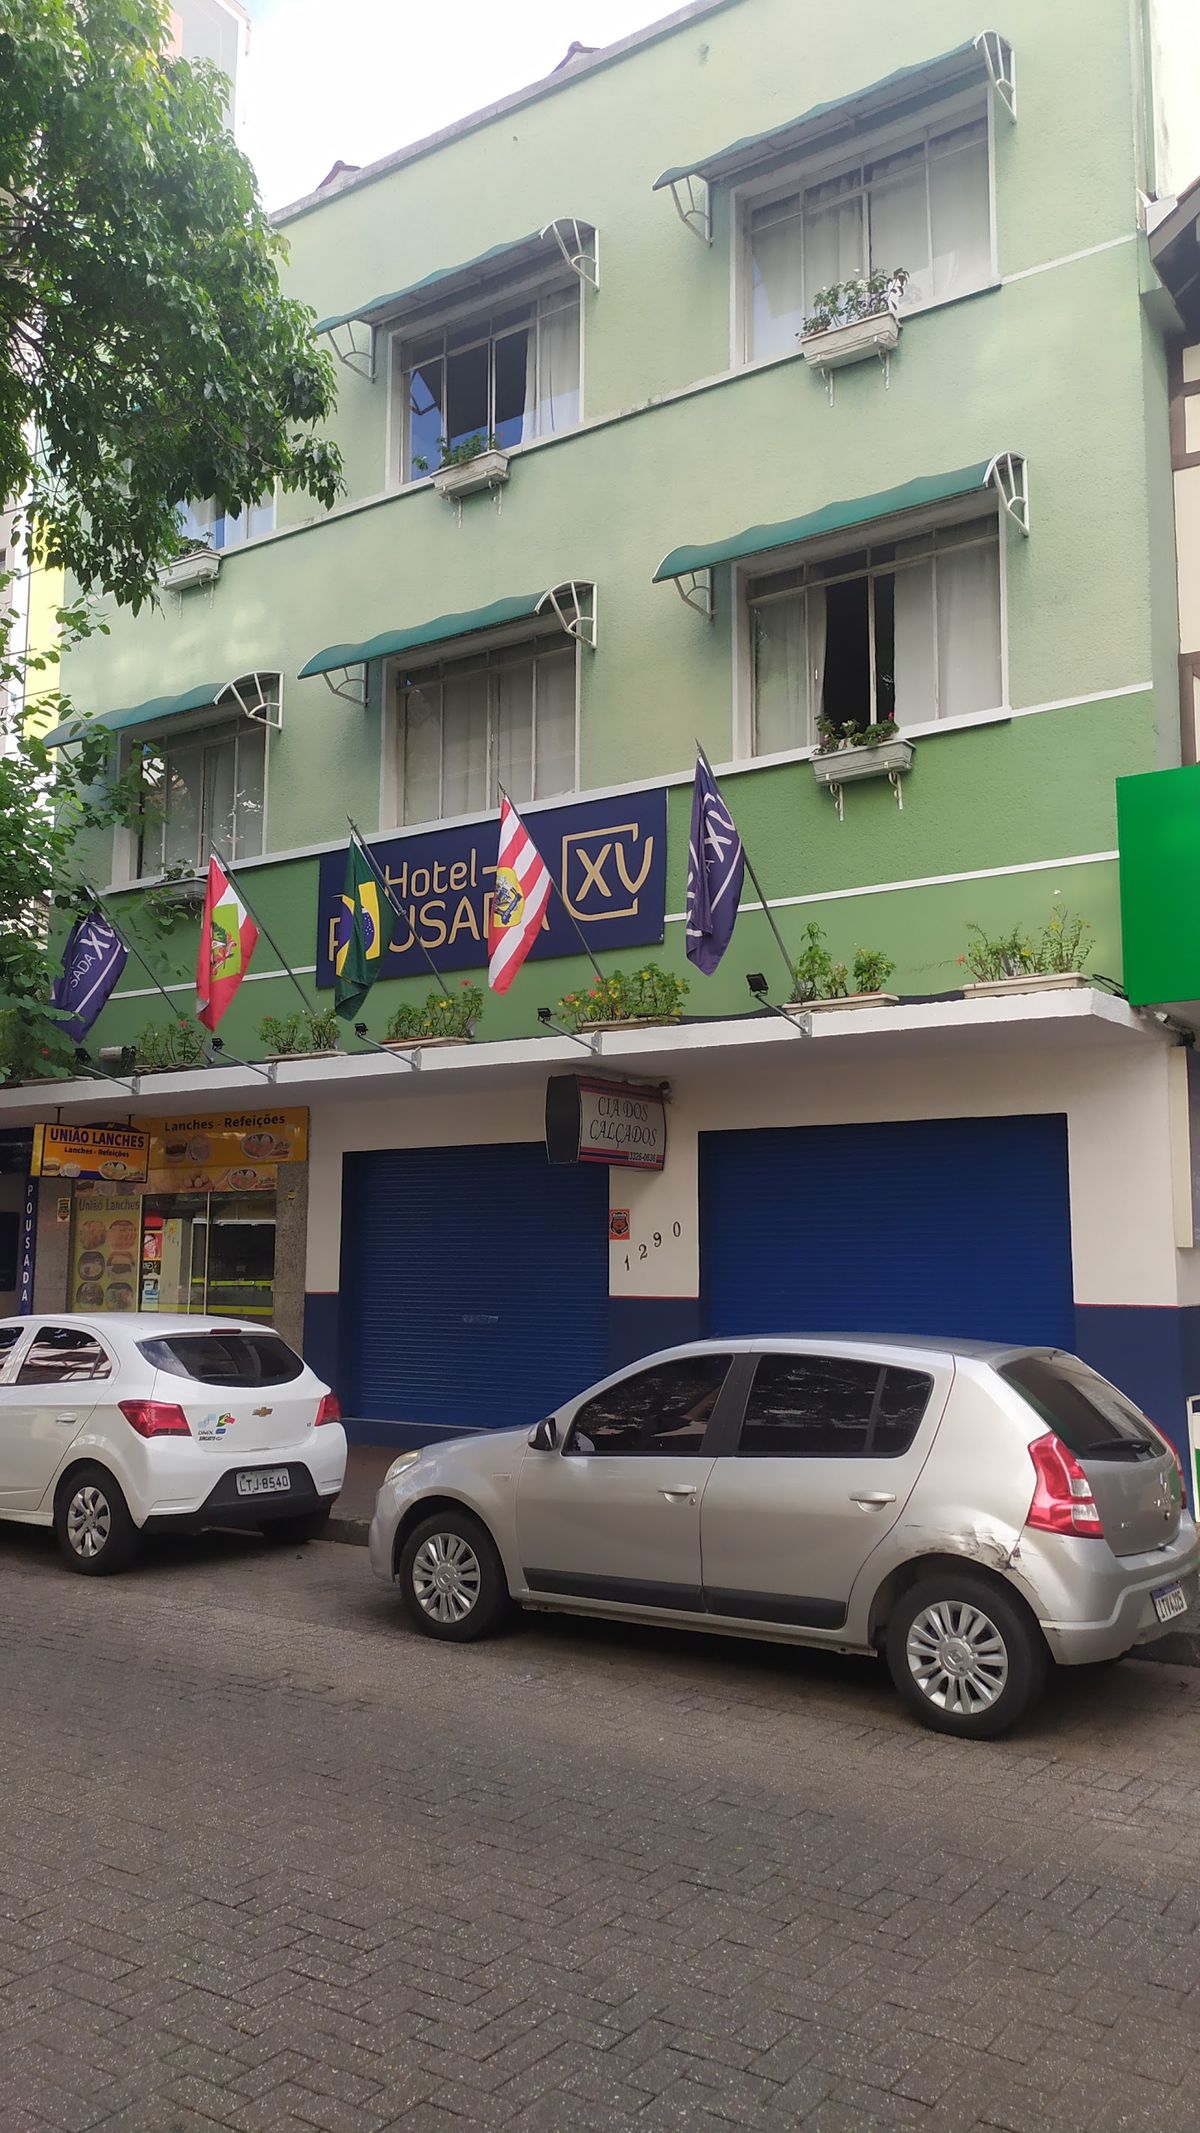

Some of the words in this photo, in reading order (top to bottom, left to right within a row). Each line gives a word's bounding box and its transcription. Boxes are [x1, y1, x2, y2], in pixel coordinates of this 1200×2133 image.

[383, 848, 478, 899] Hotel
[575, 835, 655, 903] XV
[164, 1119, 214, 1132] Lanches
[224, 1114, 286, 1129] Refeições
[597, 1096, 621, 1118] CIA
[623, 1100, 649, 1122] DOS
[92, 1131, 145, 1148] LANCHES
[589, 1119, 657, 1150] CALÇADOS
[64, 1146, 93, 1155] Lanches
[79, 1198, 103, 1212] União
[105, 1198, 140, 1211] Lanches
[21, 1184, 34, 1302] POUSADA
[624, 1220, 681, 1271] 1290
